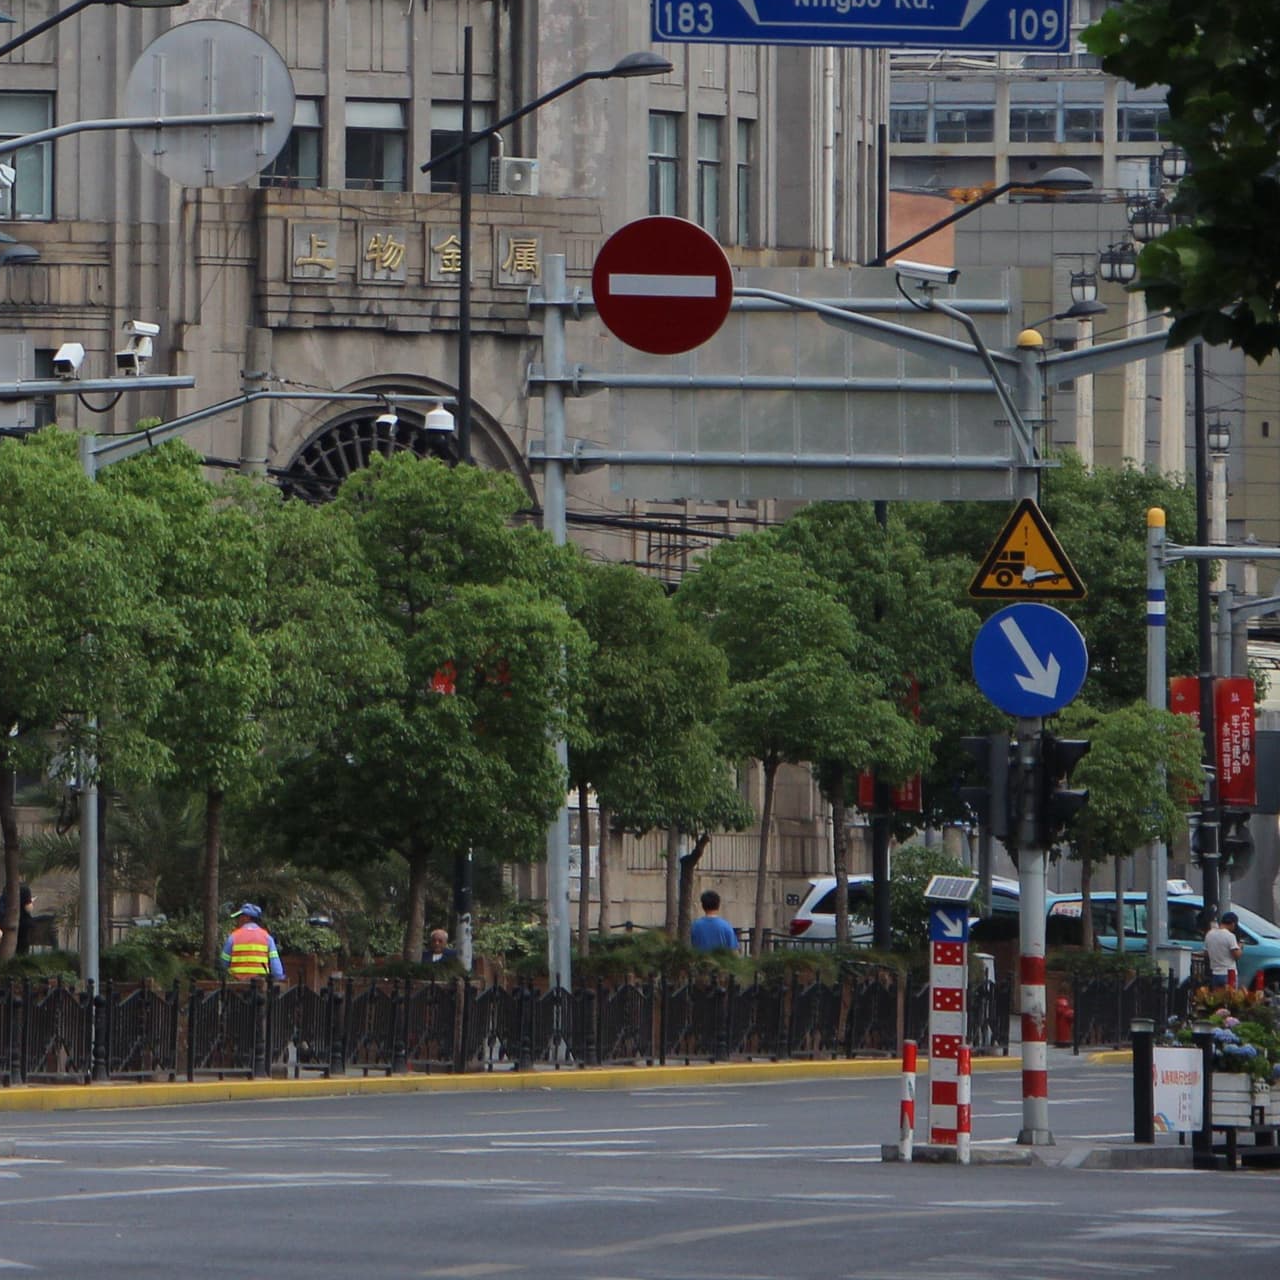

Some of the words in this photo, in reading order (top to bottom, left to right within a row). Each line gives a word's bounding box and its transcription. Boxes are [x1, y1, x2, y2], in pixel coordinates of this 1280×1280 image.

[664, 2, 714, 34] 183
[1009, 8, 1059, 41] 109
[295, 232, 542, 278] 上物金属
